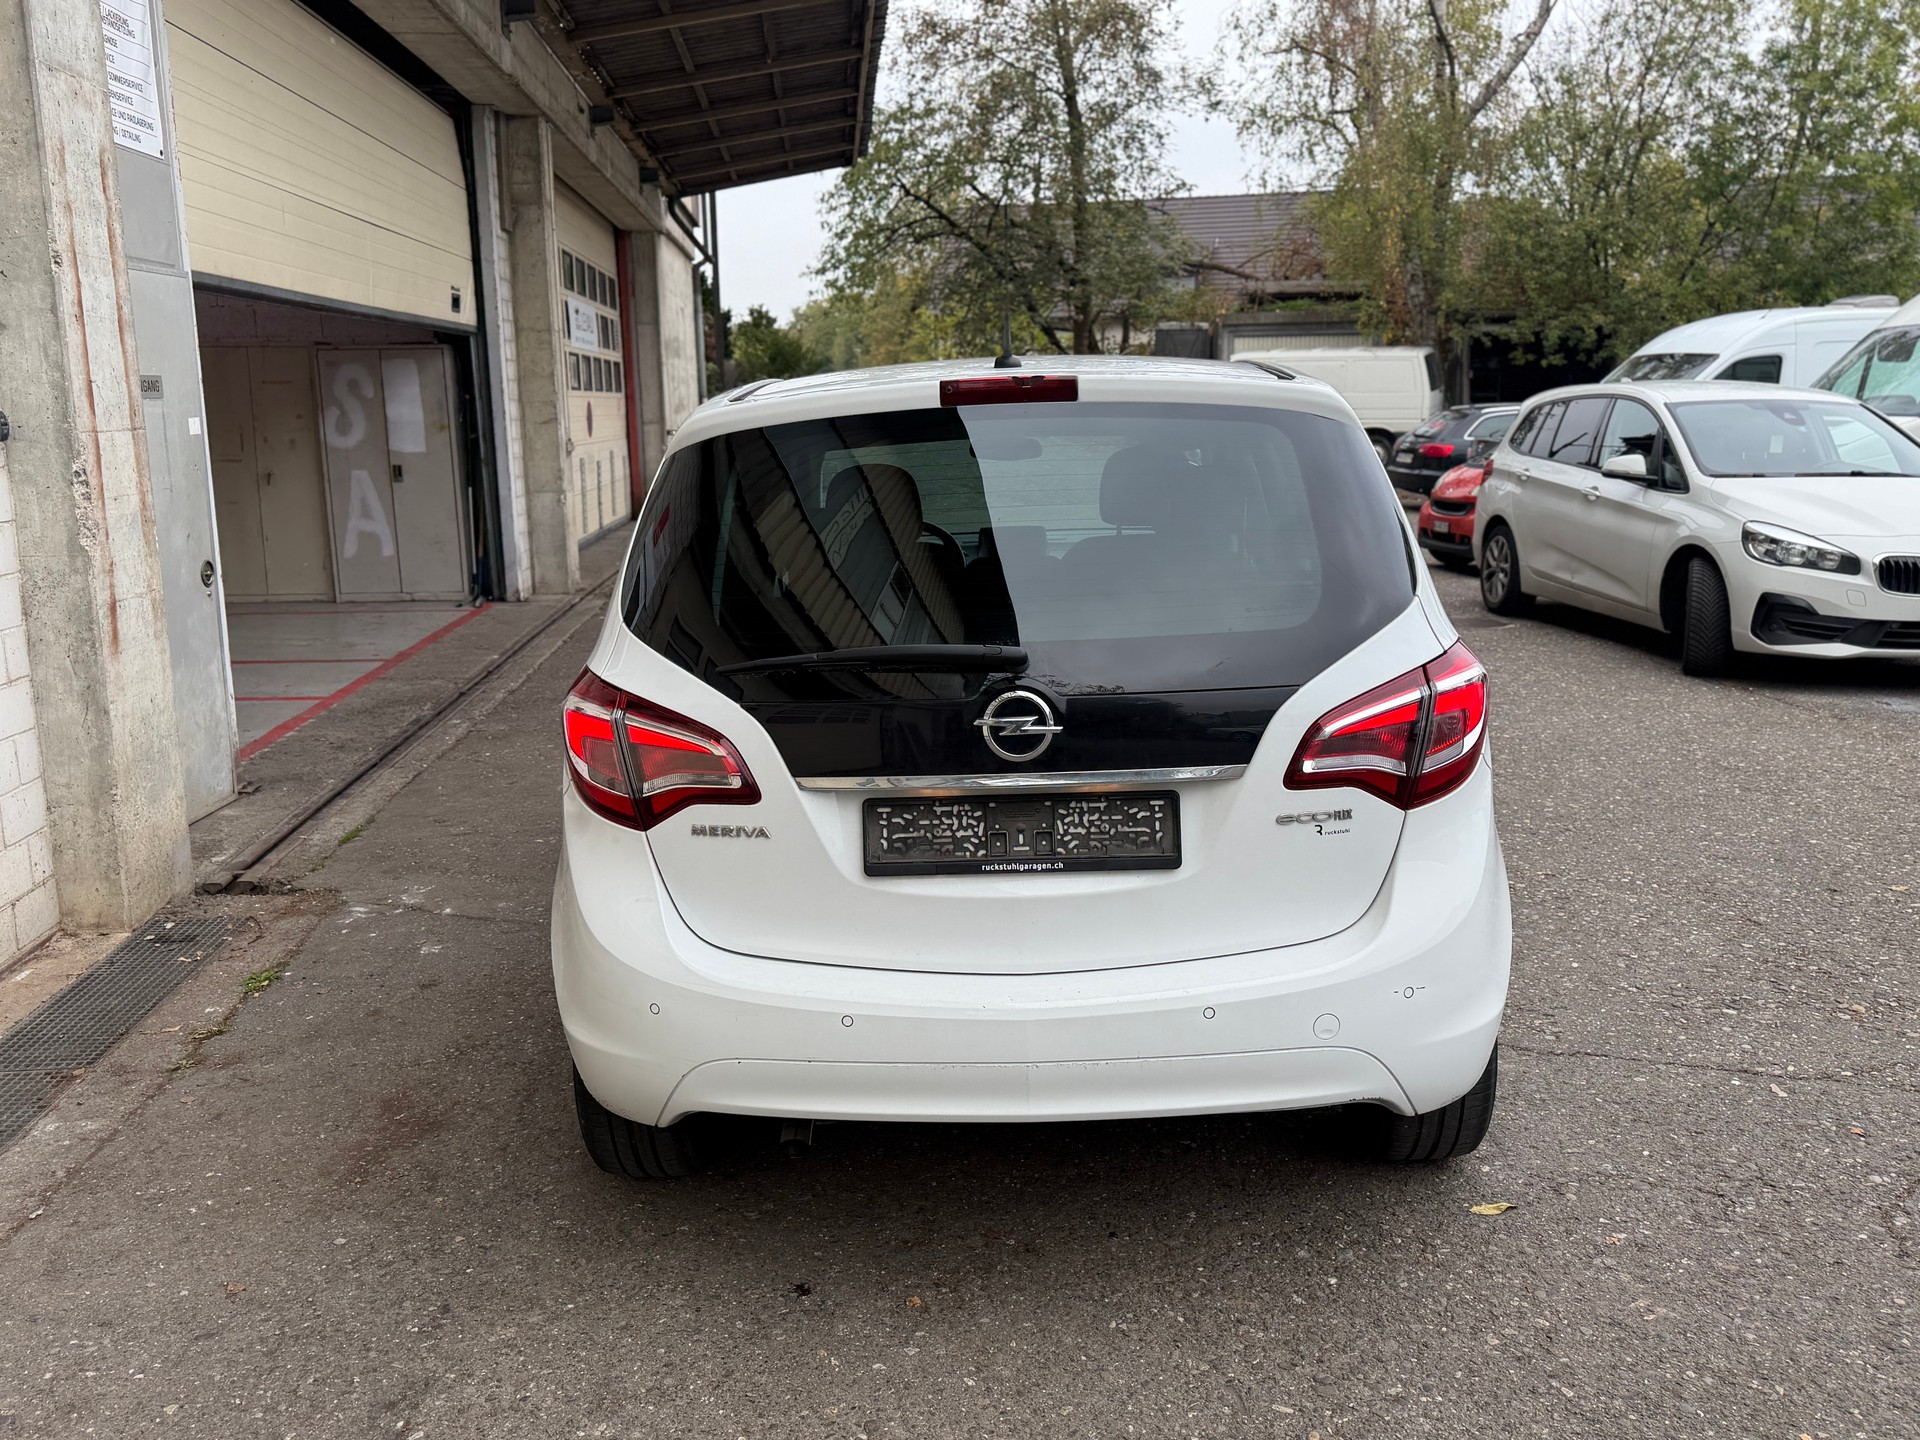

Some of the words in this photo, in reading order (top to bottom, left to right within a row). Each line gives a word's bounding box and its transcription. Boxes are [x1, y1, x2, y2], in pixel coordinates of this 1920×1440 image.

[102, 15, 136, 39] STANDSETZUNG
[691, 824, 772, 839] MERIVA
[981, 862, 1064, 871] ruckstuhlgaragen.ch
